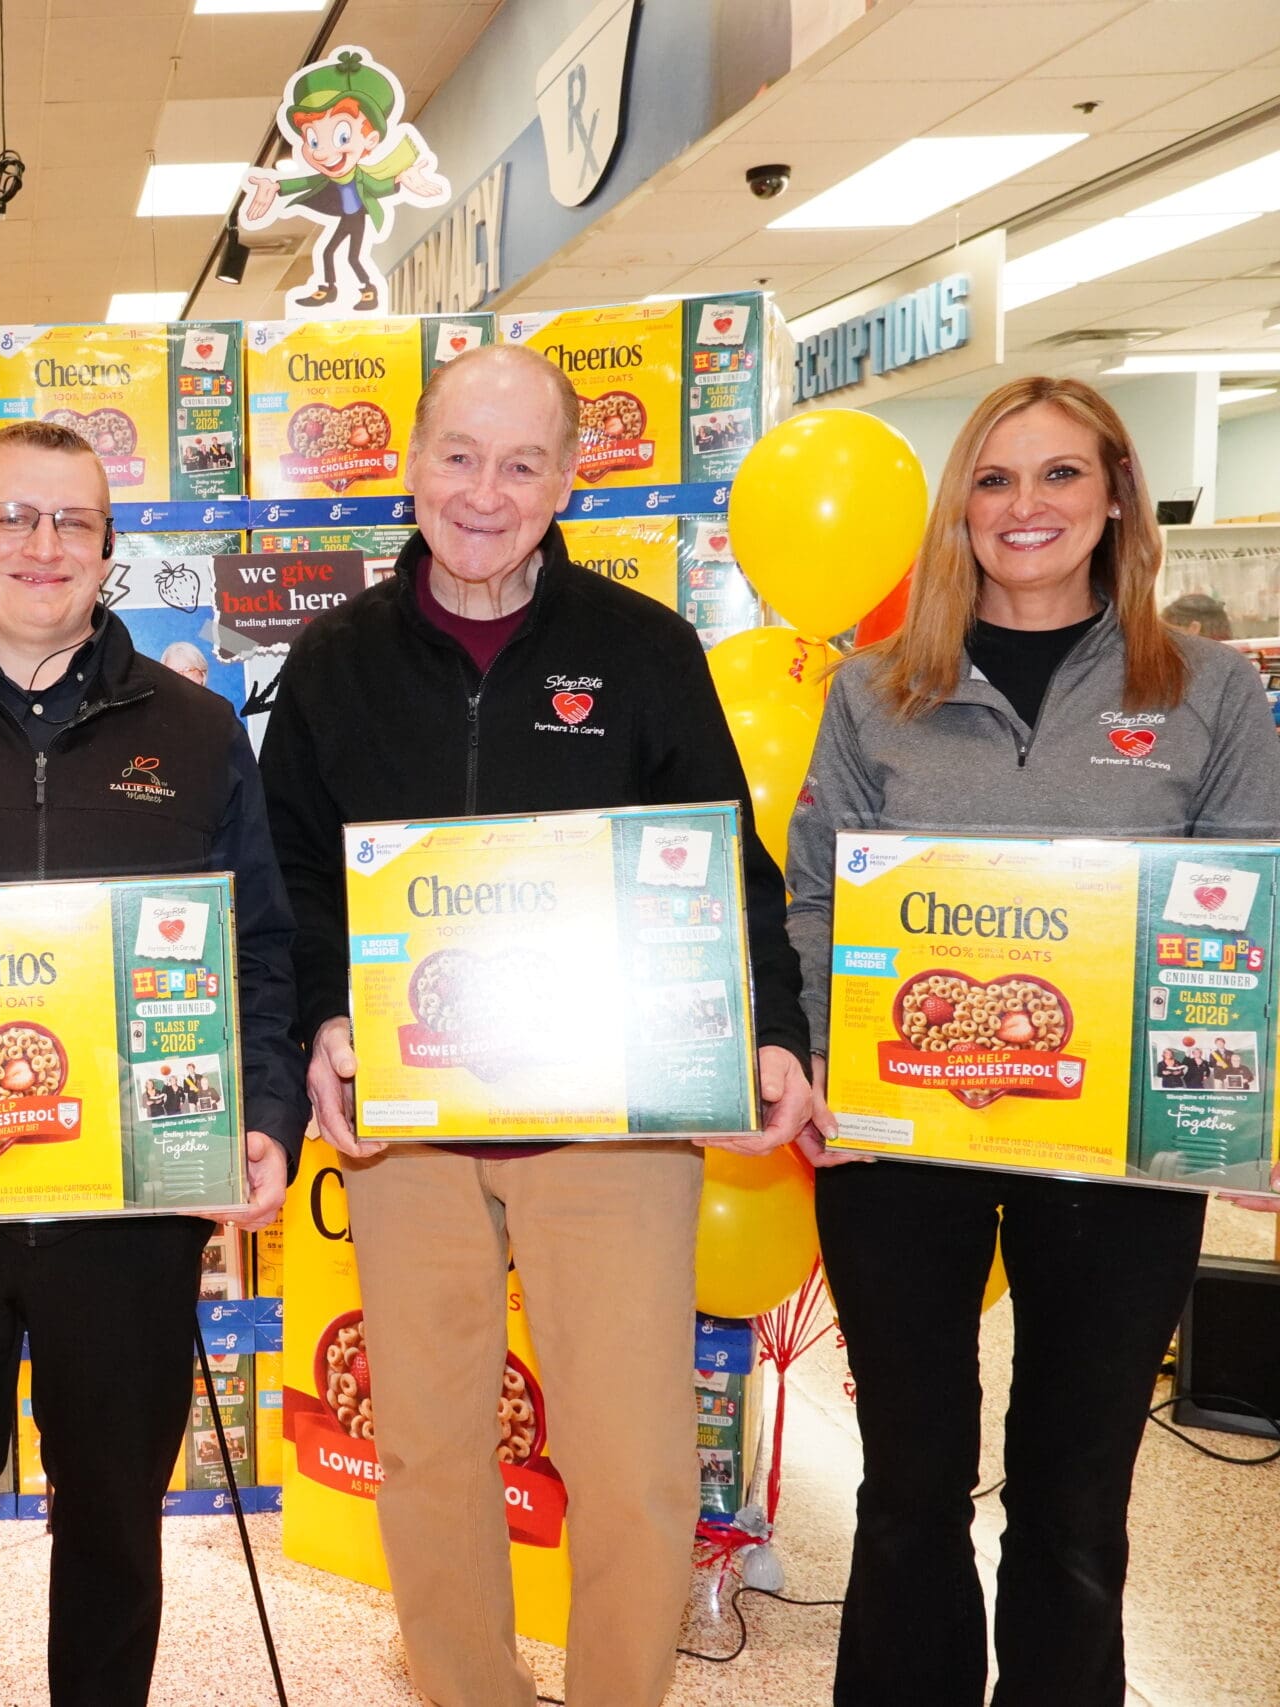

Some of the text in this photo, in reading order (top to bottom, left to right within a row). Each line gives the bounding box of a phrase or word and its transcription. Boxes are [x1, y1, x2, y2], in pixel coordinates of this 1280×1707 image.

[388, 162, 507, 315] HARMACY
[34, 358, 131, 388] Cheerios
[288, 352, 386, 382] Cheerios
[287, 458, 383, 476] LOWER CHOLESTEROL
[238, 560, 335, 588] we give
[222, 589, 347, 614] back here
[235, 617, 267, 629] Ending
[269, 616, 301, 629] Hunger
[543, 675, 604, 692] ShopRite
[1098, 711, 1167, 728] ShopRite
[534, 722, 605, 737] Partners In Caring
[1090, 756, 1171, 771] Partners In Caring
[109, 783, 176, 798] ZALLIE FAMILY
[900, 889, 1069, 942] Cheerios
[845, 951, 887, 961] 2 BOXES
[929, 945, 1052, 962] 100% OATS
[845, 959, 886, 970] INSIDE!
[1165, 972, 1252, 988] ENDING HUNGER
[6, 996, 45, 1009] OATS
[1179, 991, 1236, 1005] CLASS OF
[142, 1002, 211, 1016] ENDING HUNGER
[1185, 1005, 1229, 1026] 2026
[154, 1020, 200, 1033] CLASS OF
[160, 1033, 196, 1053] 2026
[409, 1043, 458, 1058] LOWER
[947, 1053, 1011, 1065] CAN HELP
[888, 1060, 1053, 1078] LOWER CHOLESTEROL
[1168, 1108, 1236, 1135] Together
[153, 1137, 210, 1159] Together
[319, 1447, 386, 1482] LOWER
[351, 1479, 364, 1491] AS
